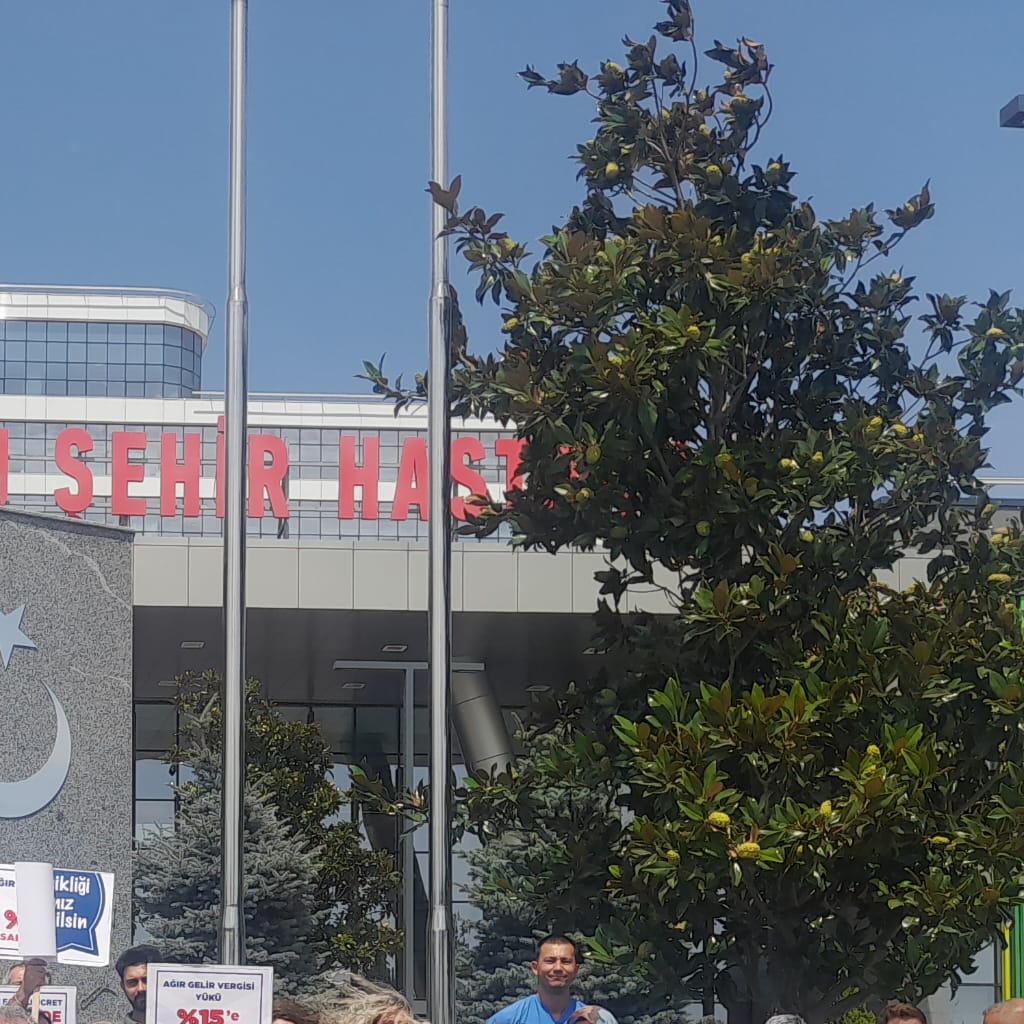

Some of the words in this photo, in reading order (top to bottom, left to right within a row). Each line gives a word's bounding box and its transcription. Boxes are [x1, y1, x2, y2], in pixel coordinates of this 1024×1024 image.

[56, 875, 91, 896] ikliği
[56, 913, 88, 930] ilsin
[163, 980, 185, 988] AĞIR
[188, 980, 215, 989] GELİR
[217, 981, 255, 991] VERGİSİ
[195, 993, 222, 1002] YÜKÜ
